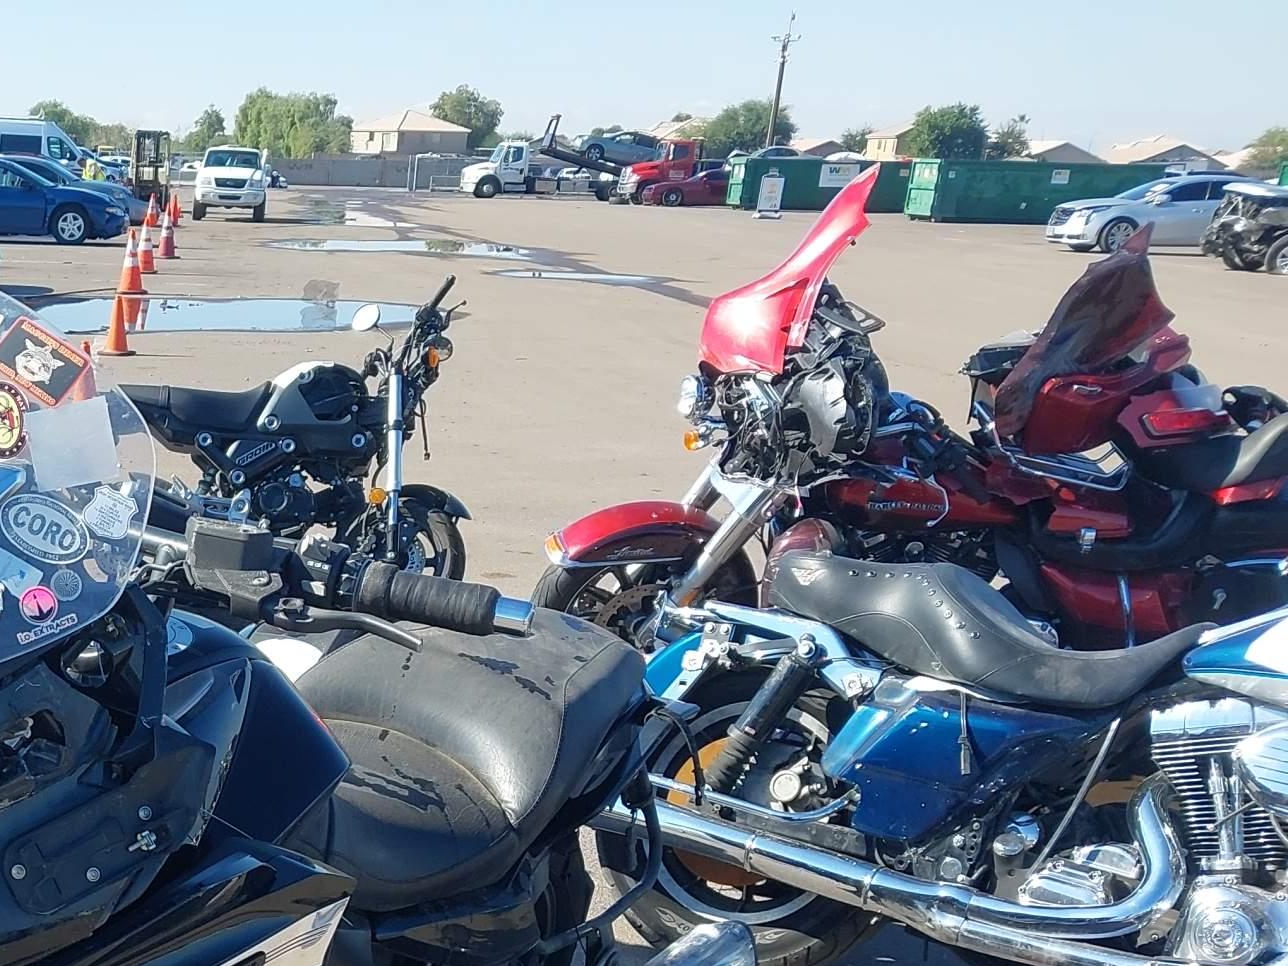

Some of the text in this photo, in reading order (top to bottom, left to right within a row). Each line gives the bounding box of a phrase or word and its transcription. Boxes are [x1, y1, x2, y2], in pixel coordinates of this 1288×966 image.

[236, 441, 276, 466] GROM
[13, 506, 77, 551] CORO
[33, 615, 76, 637] EXTRACTS
